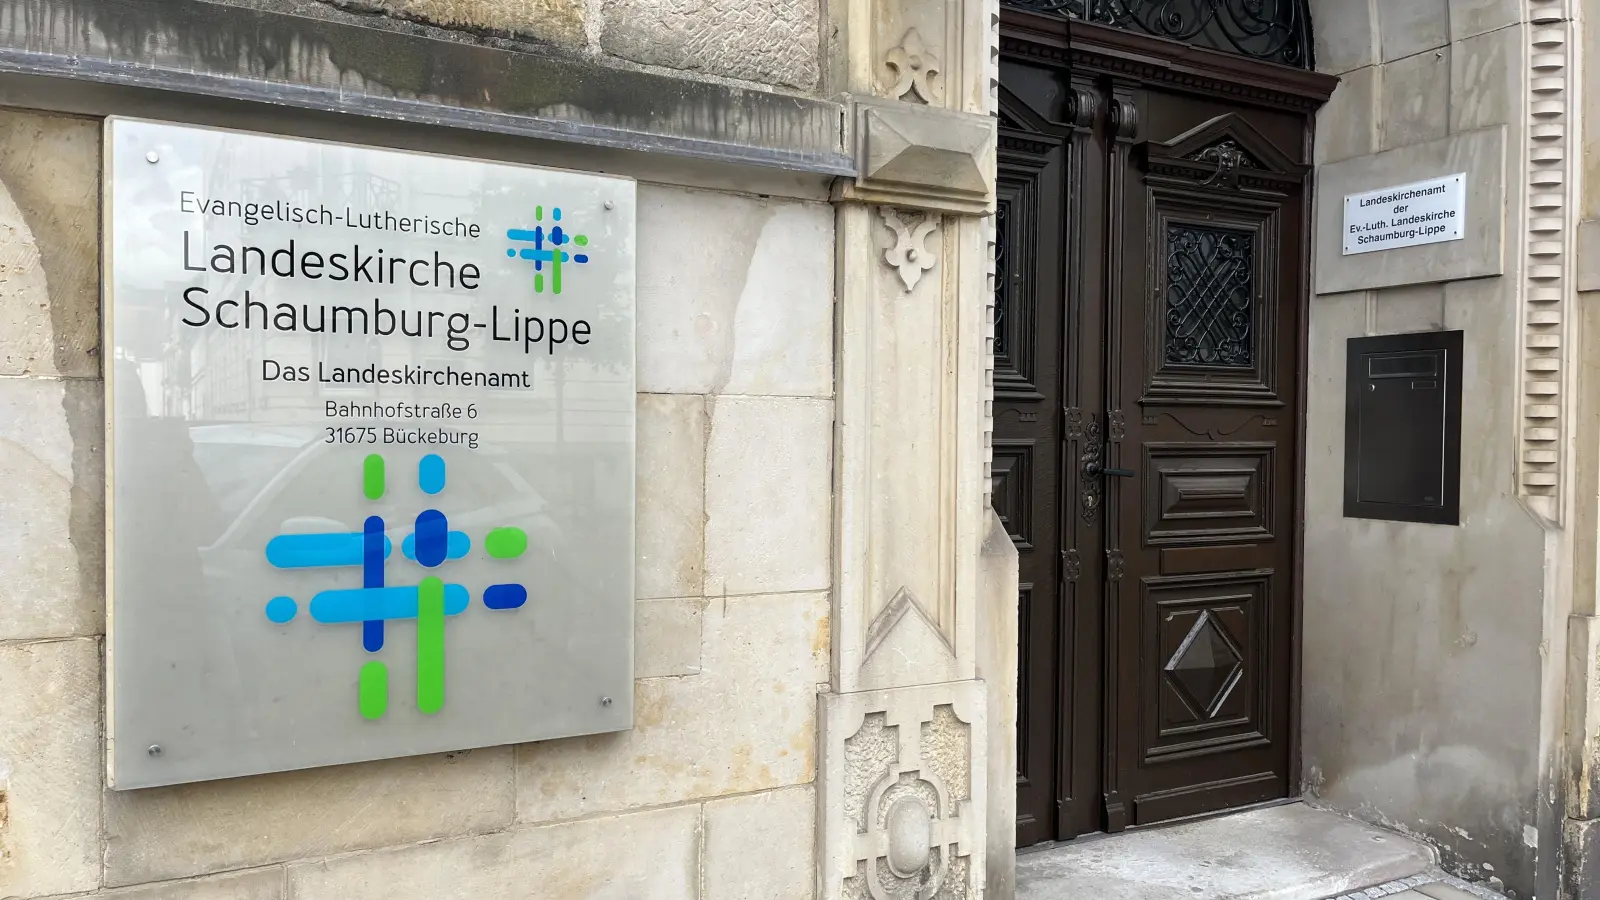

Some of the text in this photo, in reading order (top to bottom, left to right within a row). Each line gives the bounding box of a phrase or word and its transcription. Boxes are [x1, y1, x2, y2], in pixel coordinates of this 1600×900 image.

[1359, 184, 1446, 208] Landeskirchenamt
[180, 191, 481, 239] Evangelisch-Lutherische
[1393, 205, 1409, 214] der
[1349, 210, 1456, 234] Ev.-Luth. Landeskirche
[1357, 224, 1446, 244] Schaumburg-Lippe
[183, 230, 481, 290] Landeskirche
[182, 286, 592, 354] Schaumburg-Lippe
[262, 360, 531, 388] Das Landeskirchenamt
[325, 400, 478, 420] Bahnhofstraße 6
[325, 426, 479, 449] 31675 Bückeburg
